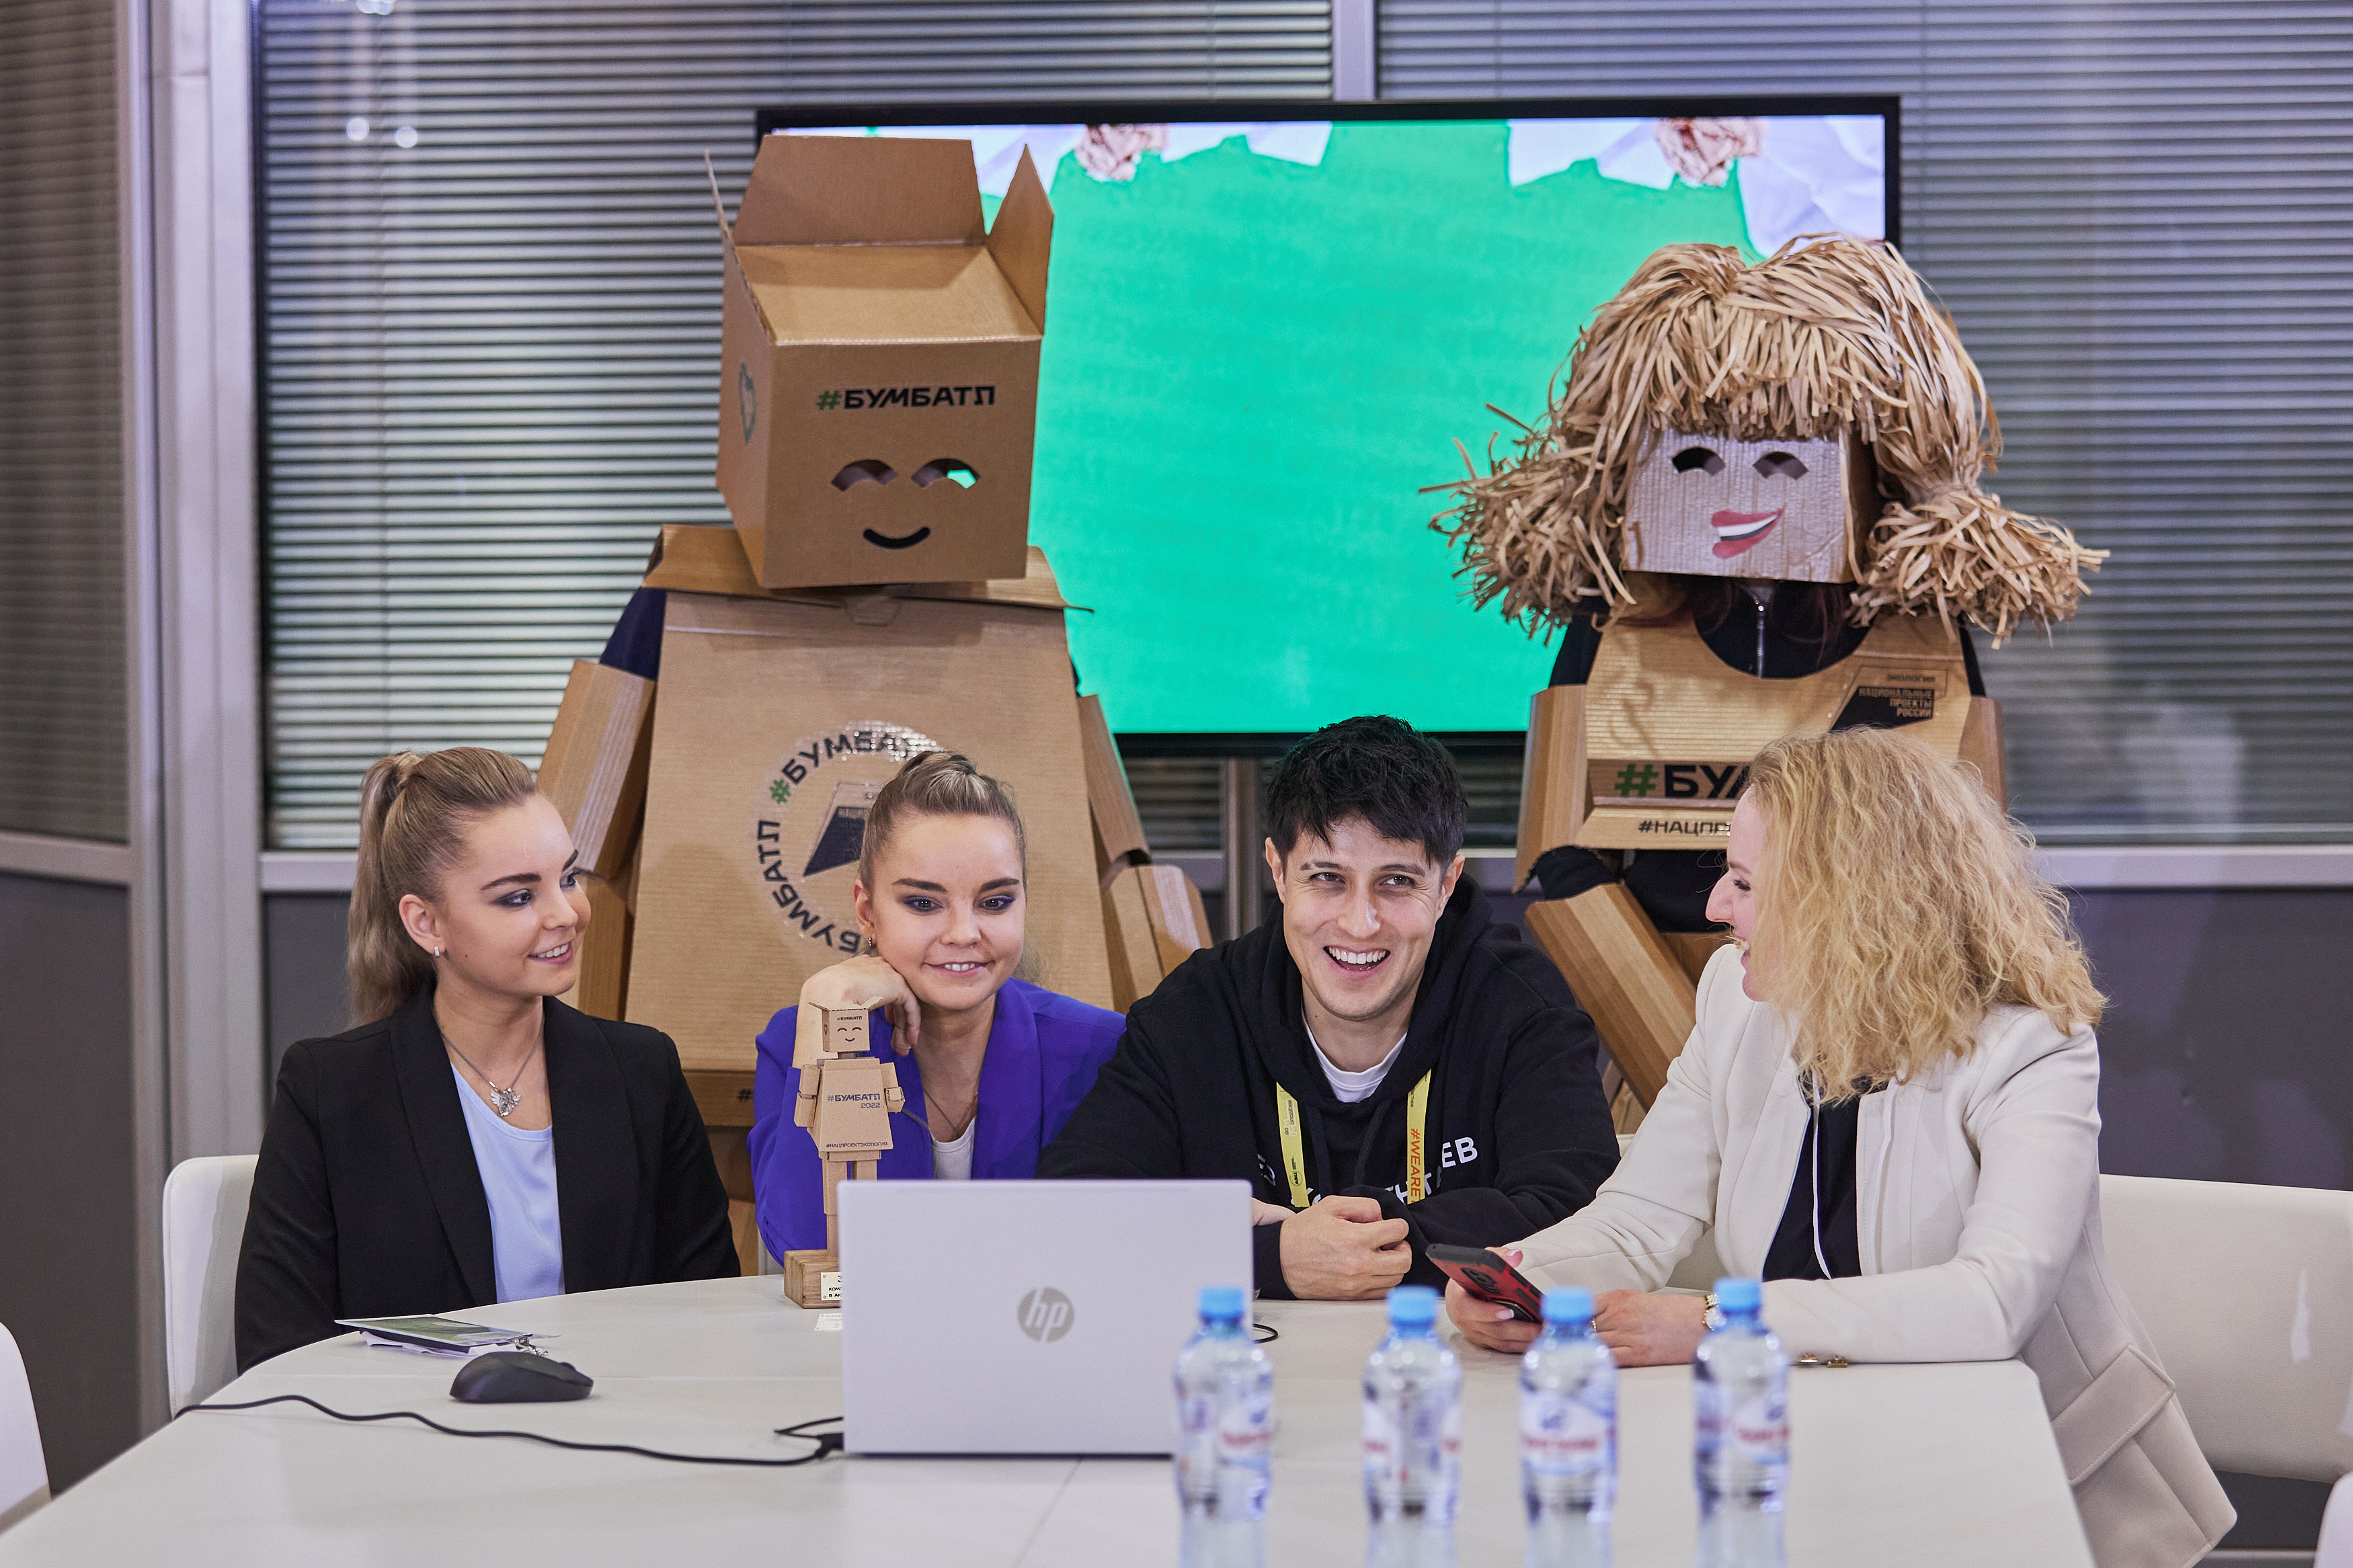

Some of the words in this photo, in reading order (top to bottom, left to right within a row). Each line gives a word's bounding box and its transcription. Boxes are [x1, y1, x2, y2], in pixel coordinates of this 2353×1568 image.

[816, 385, 996, 410] #БУМБАТЛ
[1886, 674, 1936, 682] ЭКОЛОГИЯ
[1858, 687, 1933, 699] НАЦИОНАЛЬНЫЕ
[1889, 698, 1932, 708] ПРОЕКТЫ
[1897, 708, 1932, 718] РОССИИ
[1021, 1286, 1072, 1343] hp
